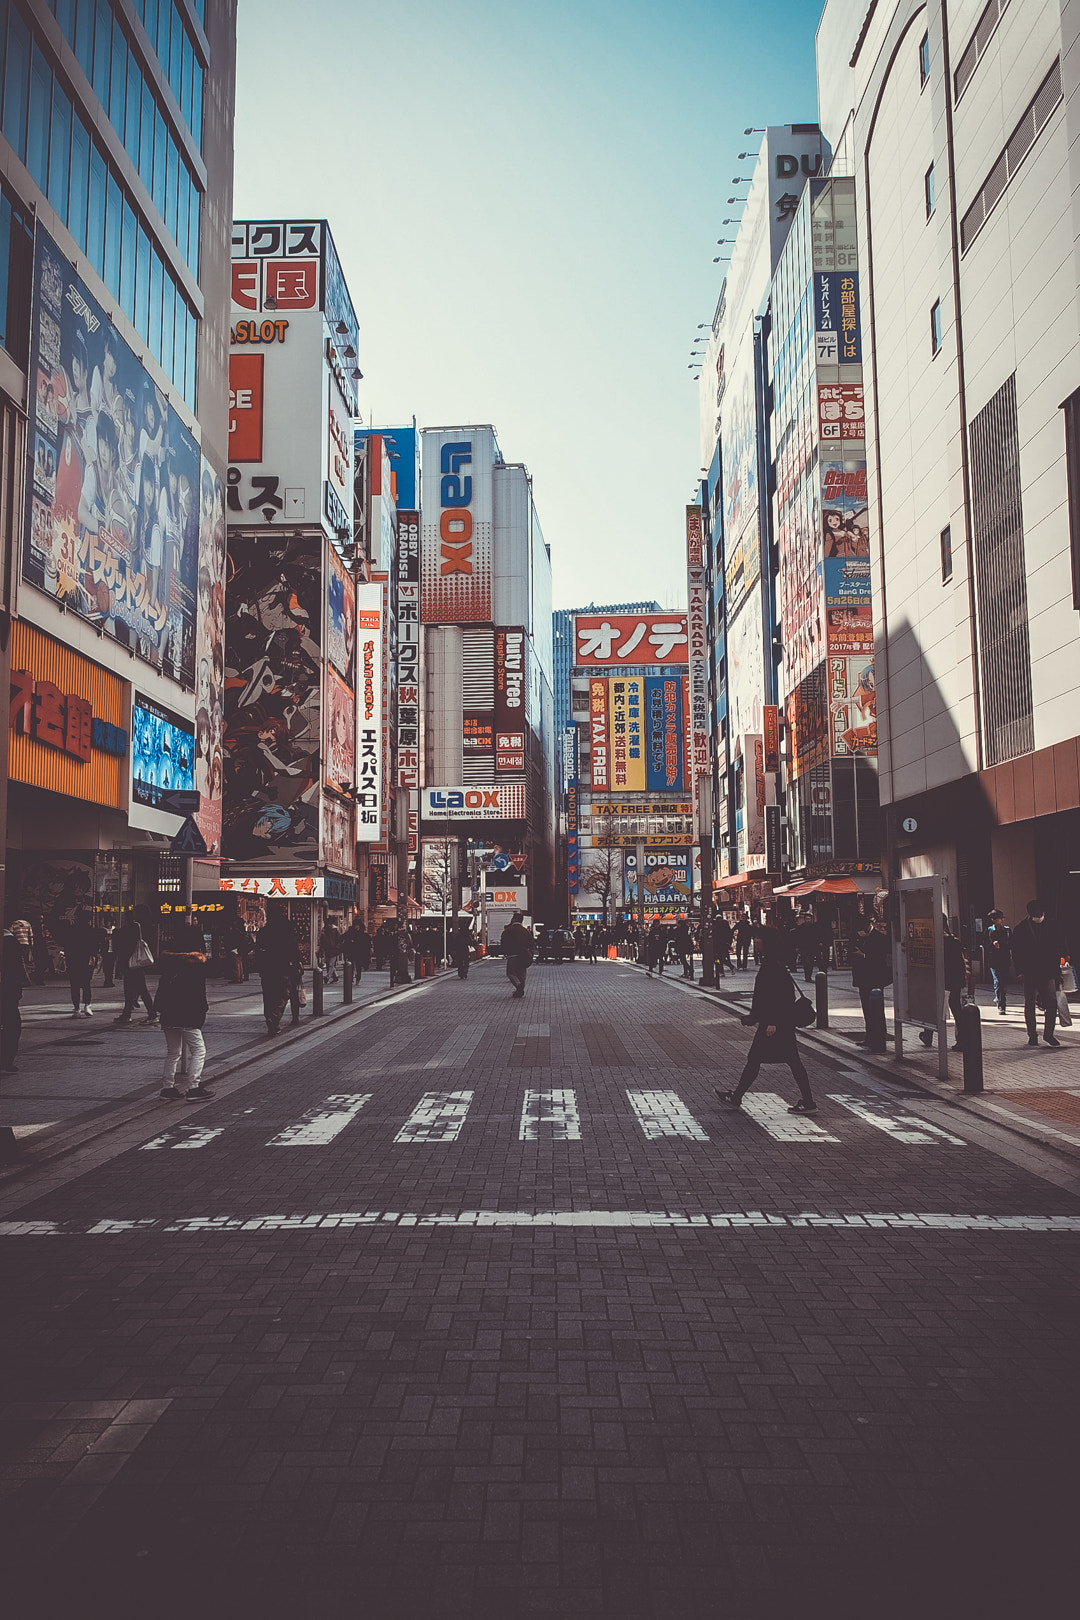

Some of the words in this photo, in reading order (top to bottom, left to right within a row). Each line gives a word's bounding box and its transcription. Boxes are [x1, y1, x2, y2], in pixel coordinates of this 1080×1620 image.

[776, 154, 821, 178] DU
[837, 253, 857, 266] 8F
[821, 275, 832, 329] レオパレス21
[841, 277, 857, 358] お部屋探しは
[817, 345, 837, 358] 7F
[820, 398, 864, 420] ぽち
[823, 425, 839, 436] 6F
[823, 485, 868, 500] Drea
[398, 514, 409, 579] PARADISE
[408, 514, 418, 558] HOBBY
[690, 587, 704, 657] TAKARADA
[496, 633, 505, 666] Flagship
[504, 633, 523, 669] Duty
[577, 620, 688, 659] オノデ
[497, 668, 505, 690] Store
[506, 672, 524, 708] Free
[592, 682, 605, 713] 免税
[692, 694, 706, 729] 免税商店
[498, 736, 522, 748] 免税
[592, 713, 606, 744] TAX
[498, 756, 522, 766] 면세점
[566, 727, 576, 780] Panasonic
[593, 746, 607, 786] FREE
[568, 786, 577, 830] ONODEN
[596, 805, 618, 814] TAX
[621, 805, 650, 814] FREE
[651, 804, 678, 814] 免税店
[650, 836, 682, 845] エアコン
